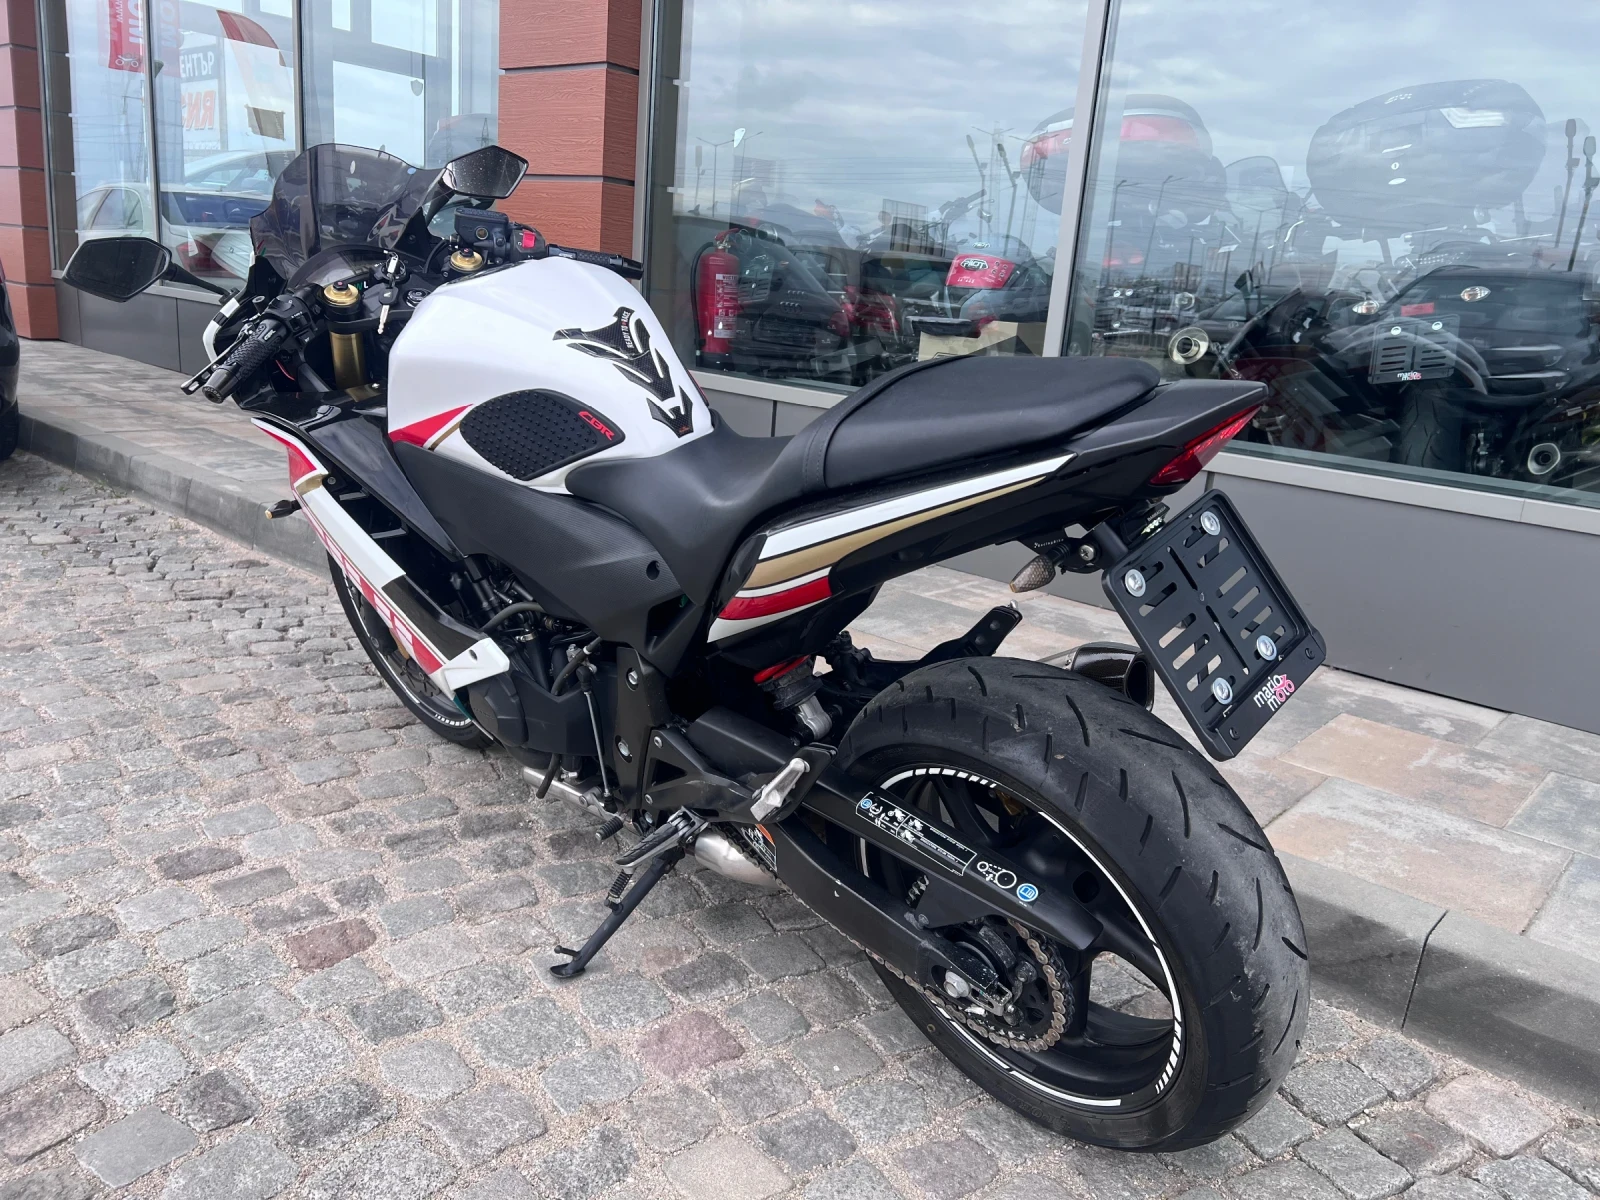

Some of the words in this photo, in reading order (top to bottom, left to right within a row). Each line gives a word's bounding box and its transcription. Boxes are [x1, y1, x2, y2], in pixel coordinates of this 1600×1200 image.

[620, 310, 631, 322] RACE
[622, 332, 635, 349] READY
[578, 411, 615, 440] CBR
[1253, 674, 1281, 708] mario
[1267, 679, 1295, 711] moto
